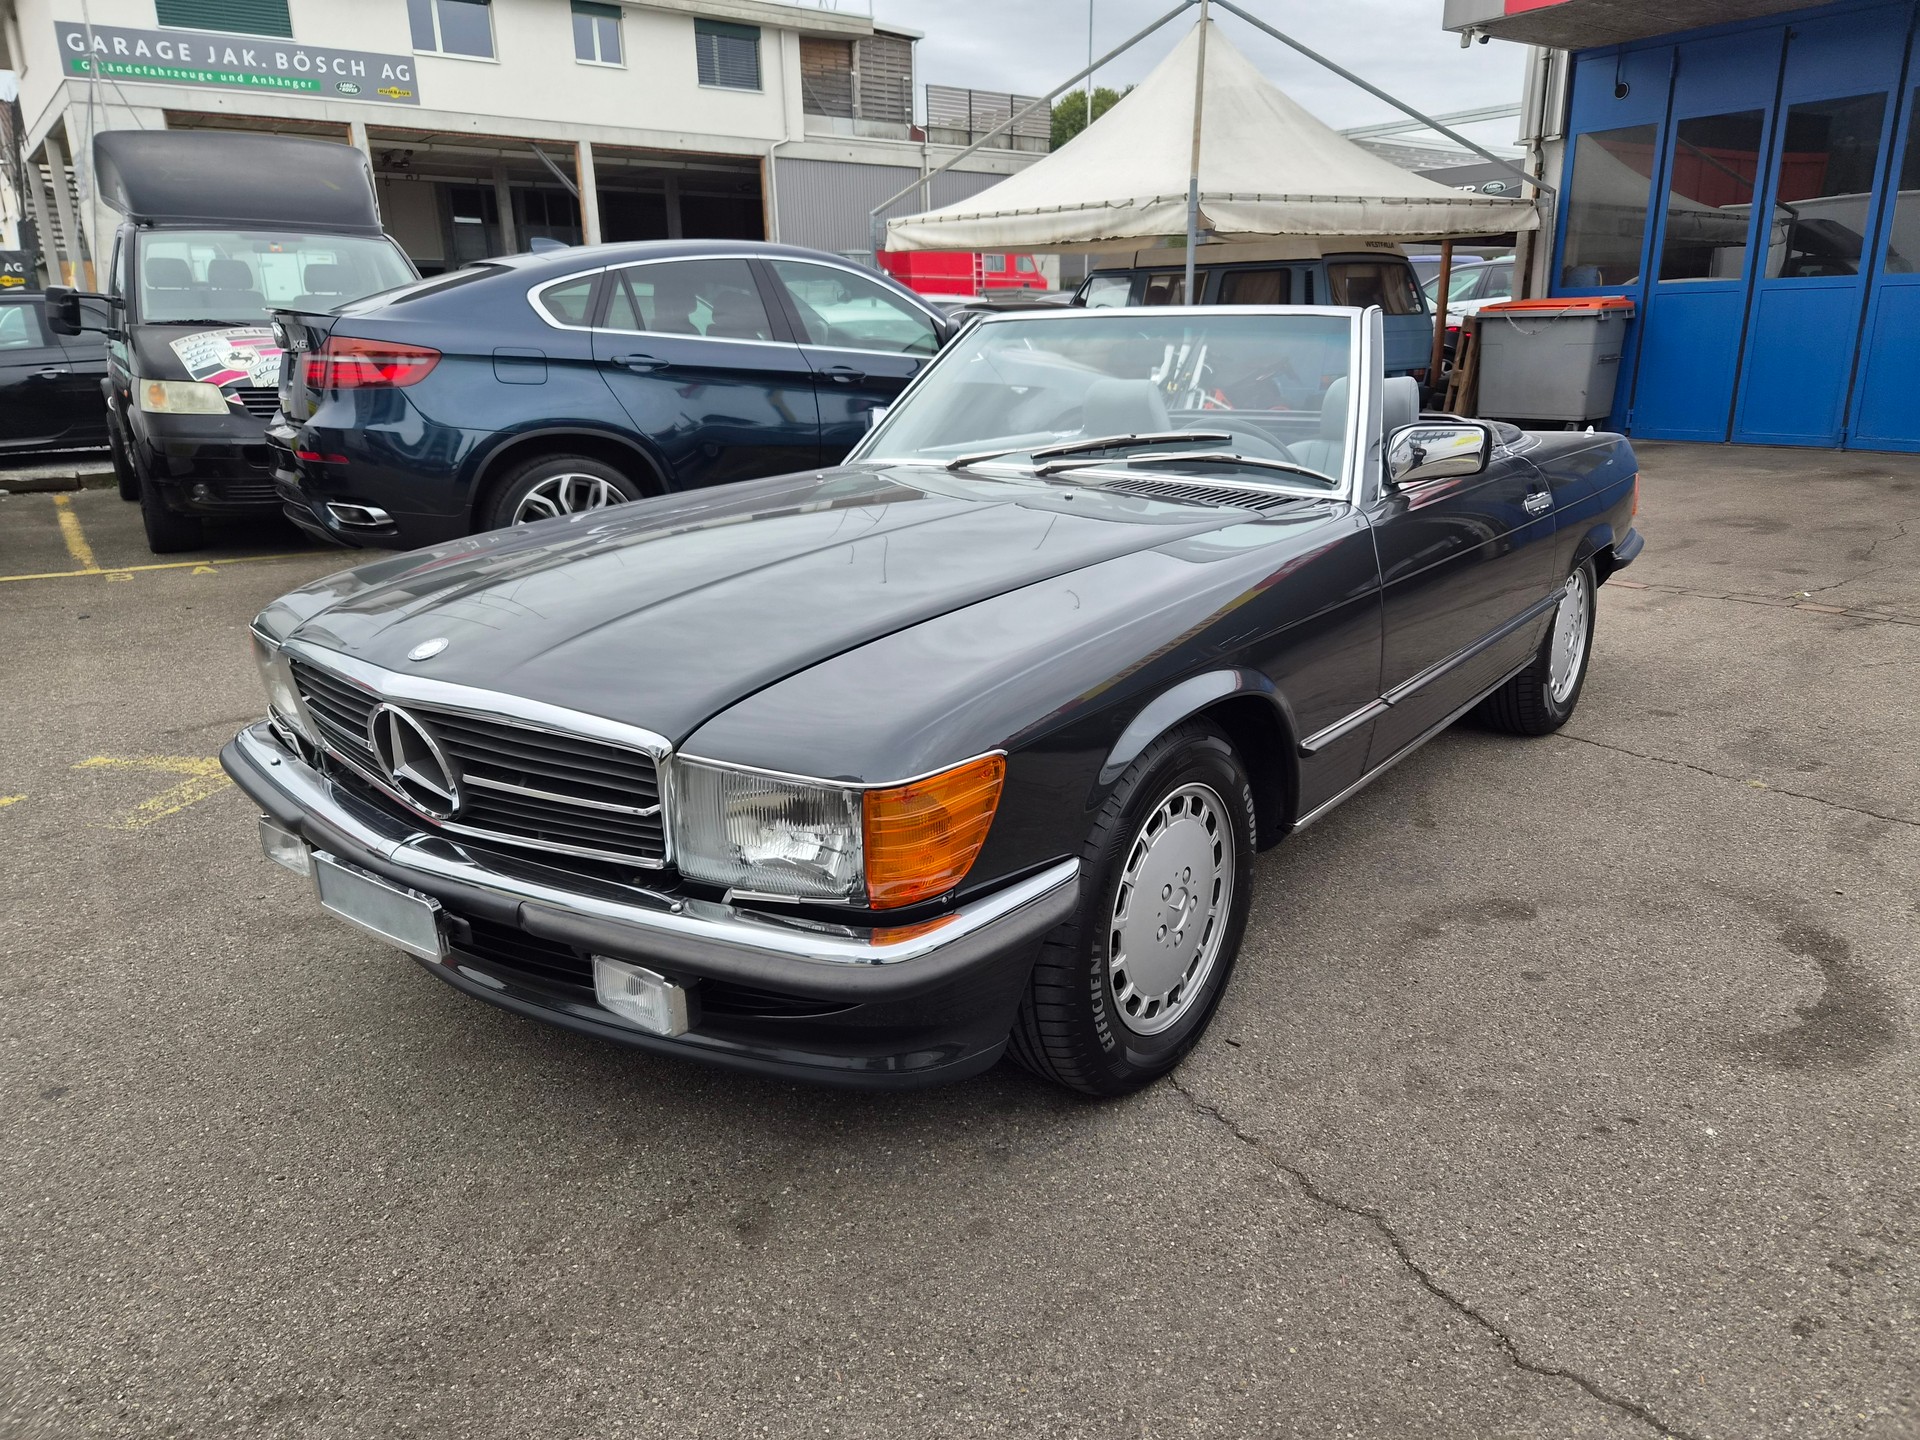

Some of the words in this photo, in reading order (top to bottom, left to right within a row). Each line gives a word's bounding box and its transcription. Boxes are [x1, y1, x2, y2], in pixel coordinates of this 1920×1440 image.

[66, 33, 191, 61] GARAGE
[207, 46, 267, 67] JAK.
[275, 51, 366, 77] BÖSCH
[381, 63, 410, 81] AG
[81, 61, 213, 81] Gändefahrzeuge
[220, 74, 244, 83] und
[251, 76, 313, 90] Anhänger
[4, 262, 23, 273] AG
[1090, 940, 1116, 1054] EFFICIENT
